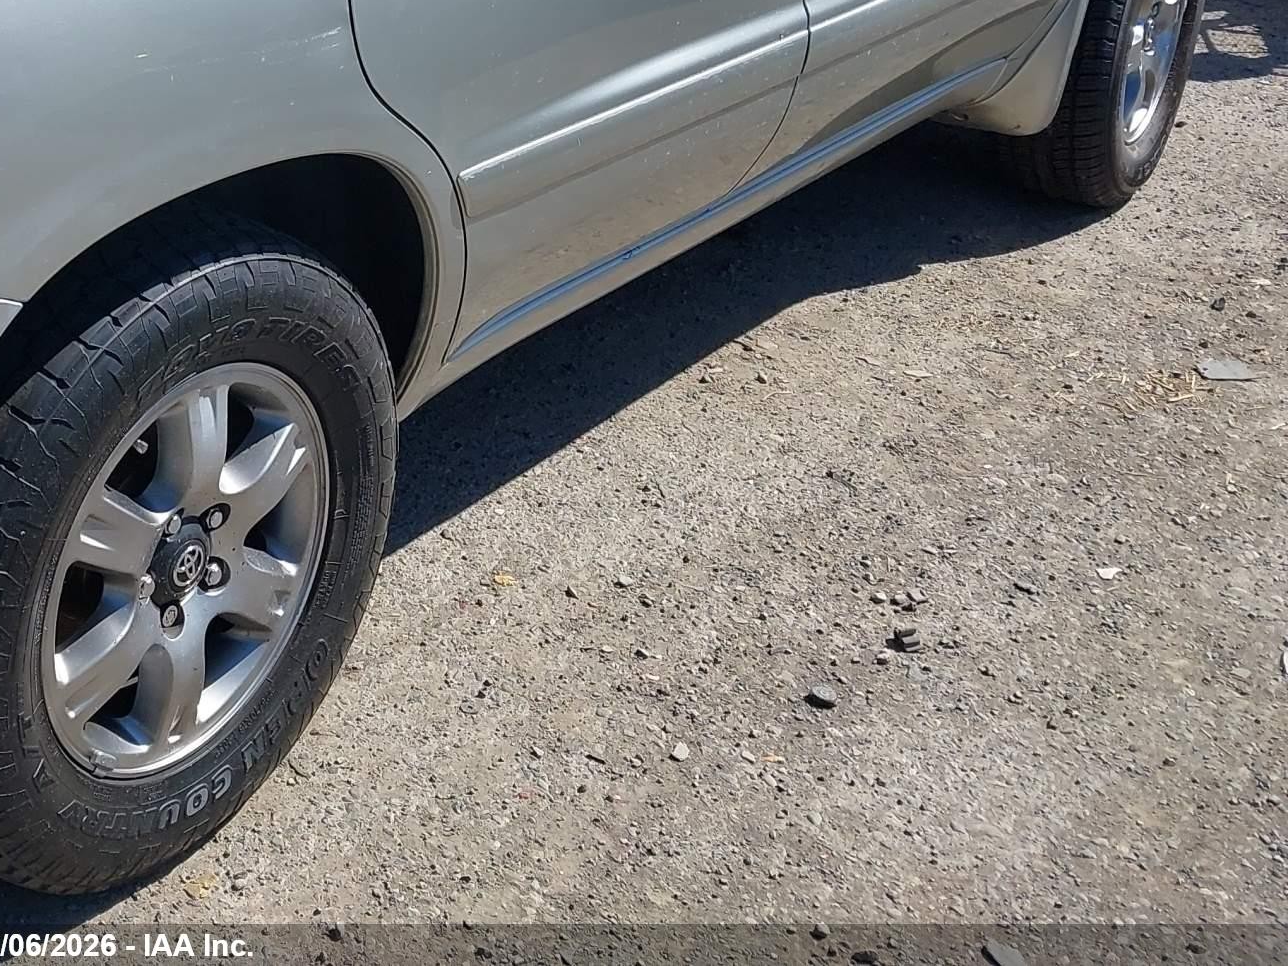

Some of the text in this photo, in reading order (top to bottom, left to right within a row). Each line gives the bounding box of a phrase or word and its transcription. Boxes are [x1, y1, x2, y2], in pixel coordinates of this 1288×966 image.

[260, 315, 363, 392] TIRES
[240, 637, 330, 773] OPEN
[57, 764, 233, 838] COUNTRY
